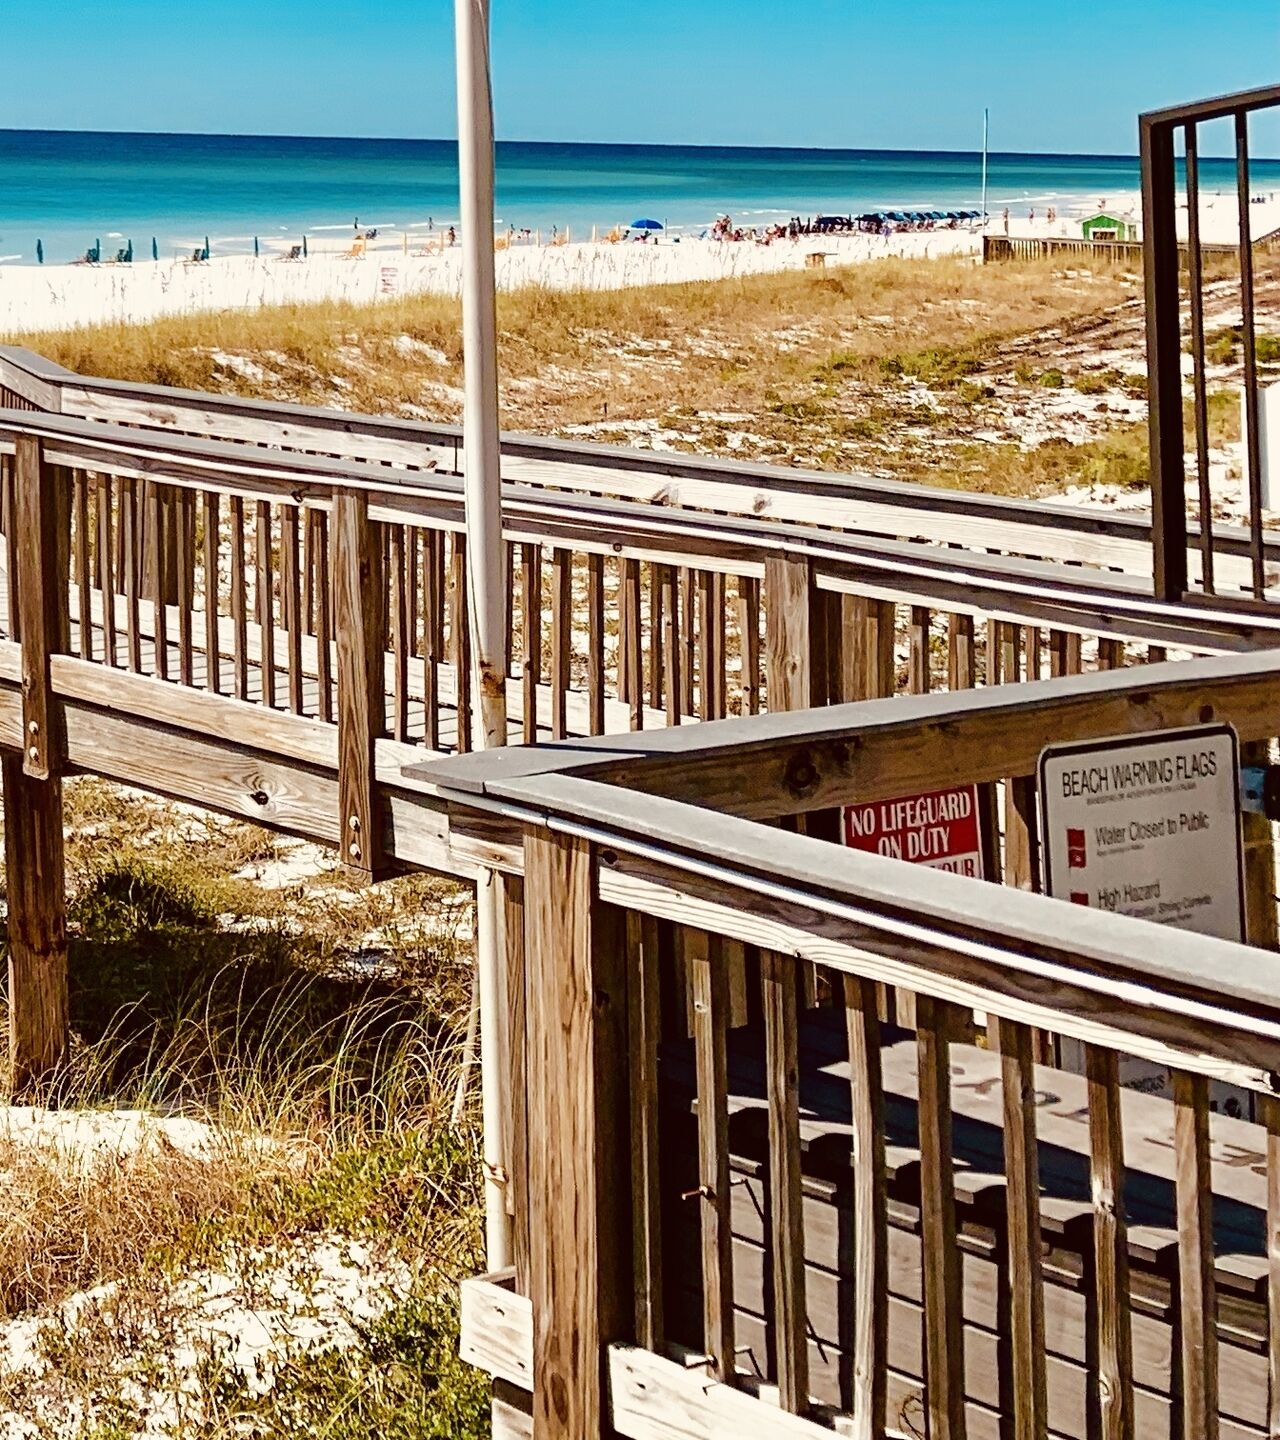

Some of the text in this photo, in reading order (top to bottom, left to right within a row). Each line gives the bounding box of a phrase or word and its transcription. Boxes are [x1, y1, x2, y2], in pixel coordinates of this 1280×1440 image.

[1062, 768, 1109, 797] BEACH
[1111, 757, 1173, 789] WARNING
[1175, 750, 1217, 780] FLAGS
[851, 792, 971, 837] NO LIFEGUARD
[1095, 811, 1210, 846] Water Closed to Public
[878, 826, 950, 860] ON DUTY
[1098, 878, 1160, 911] High Hazard
